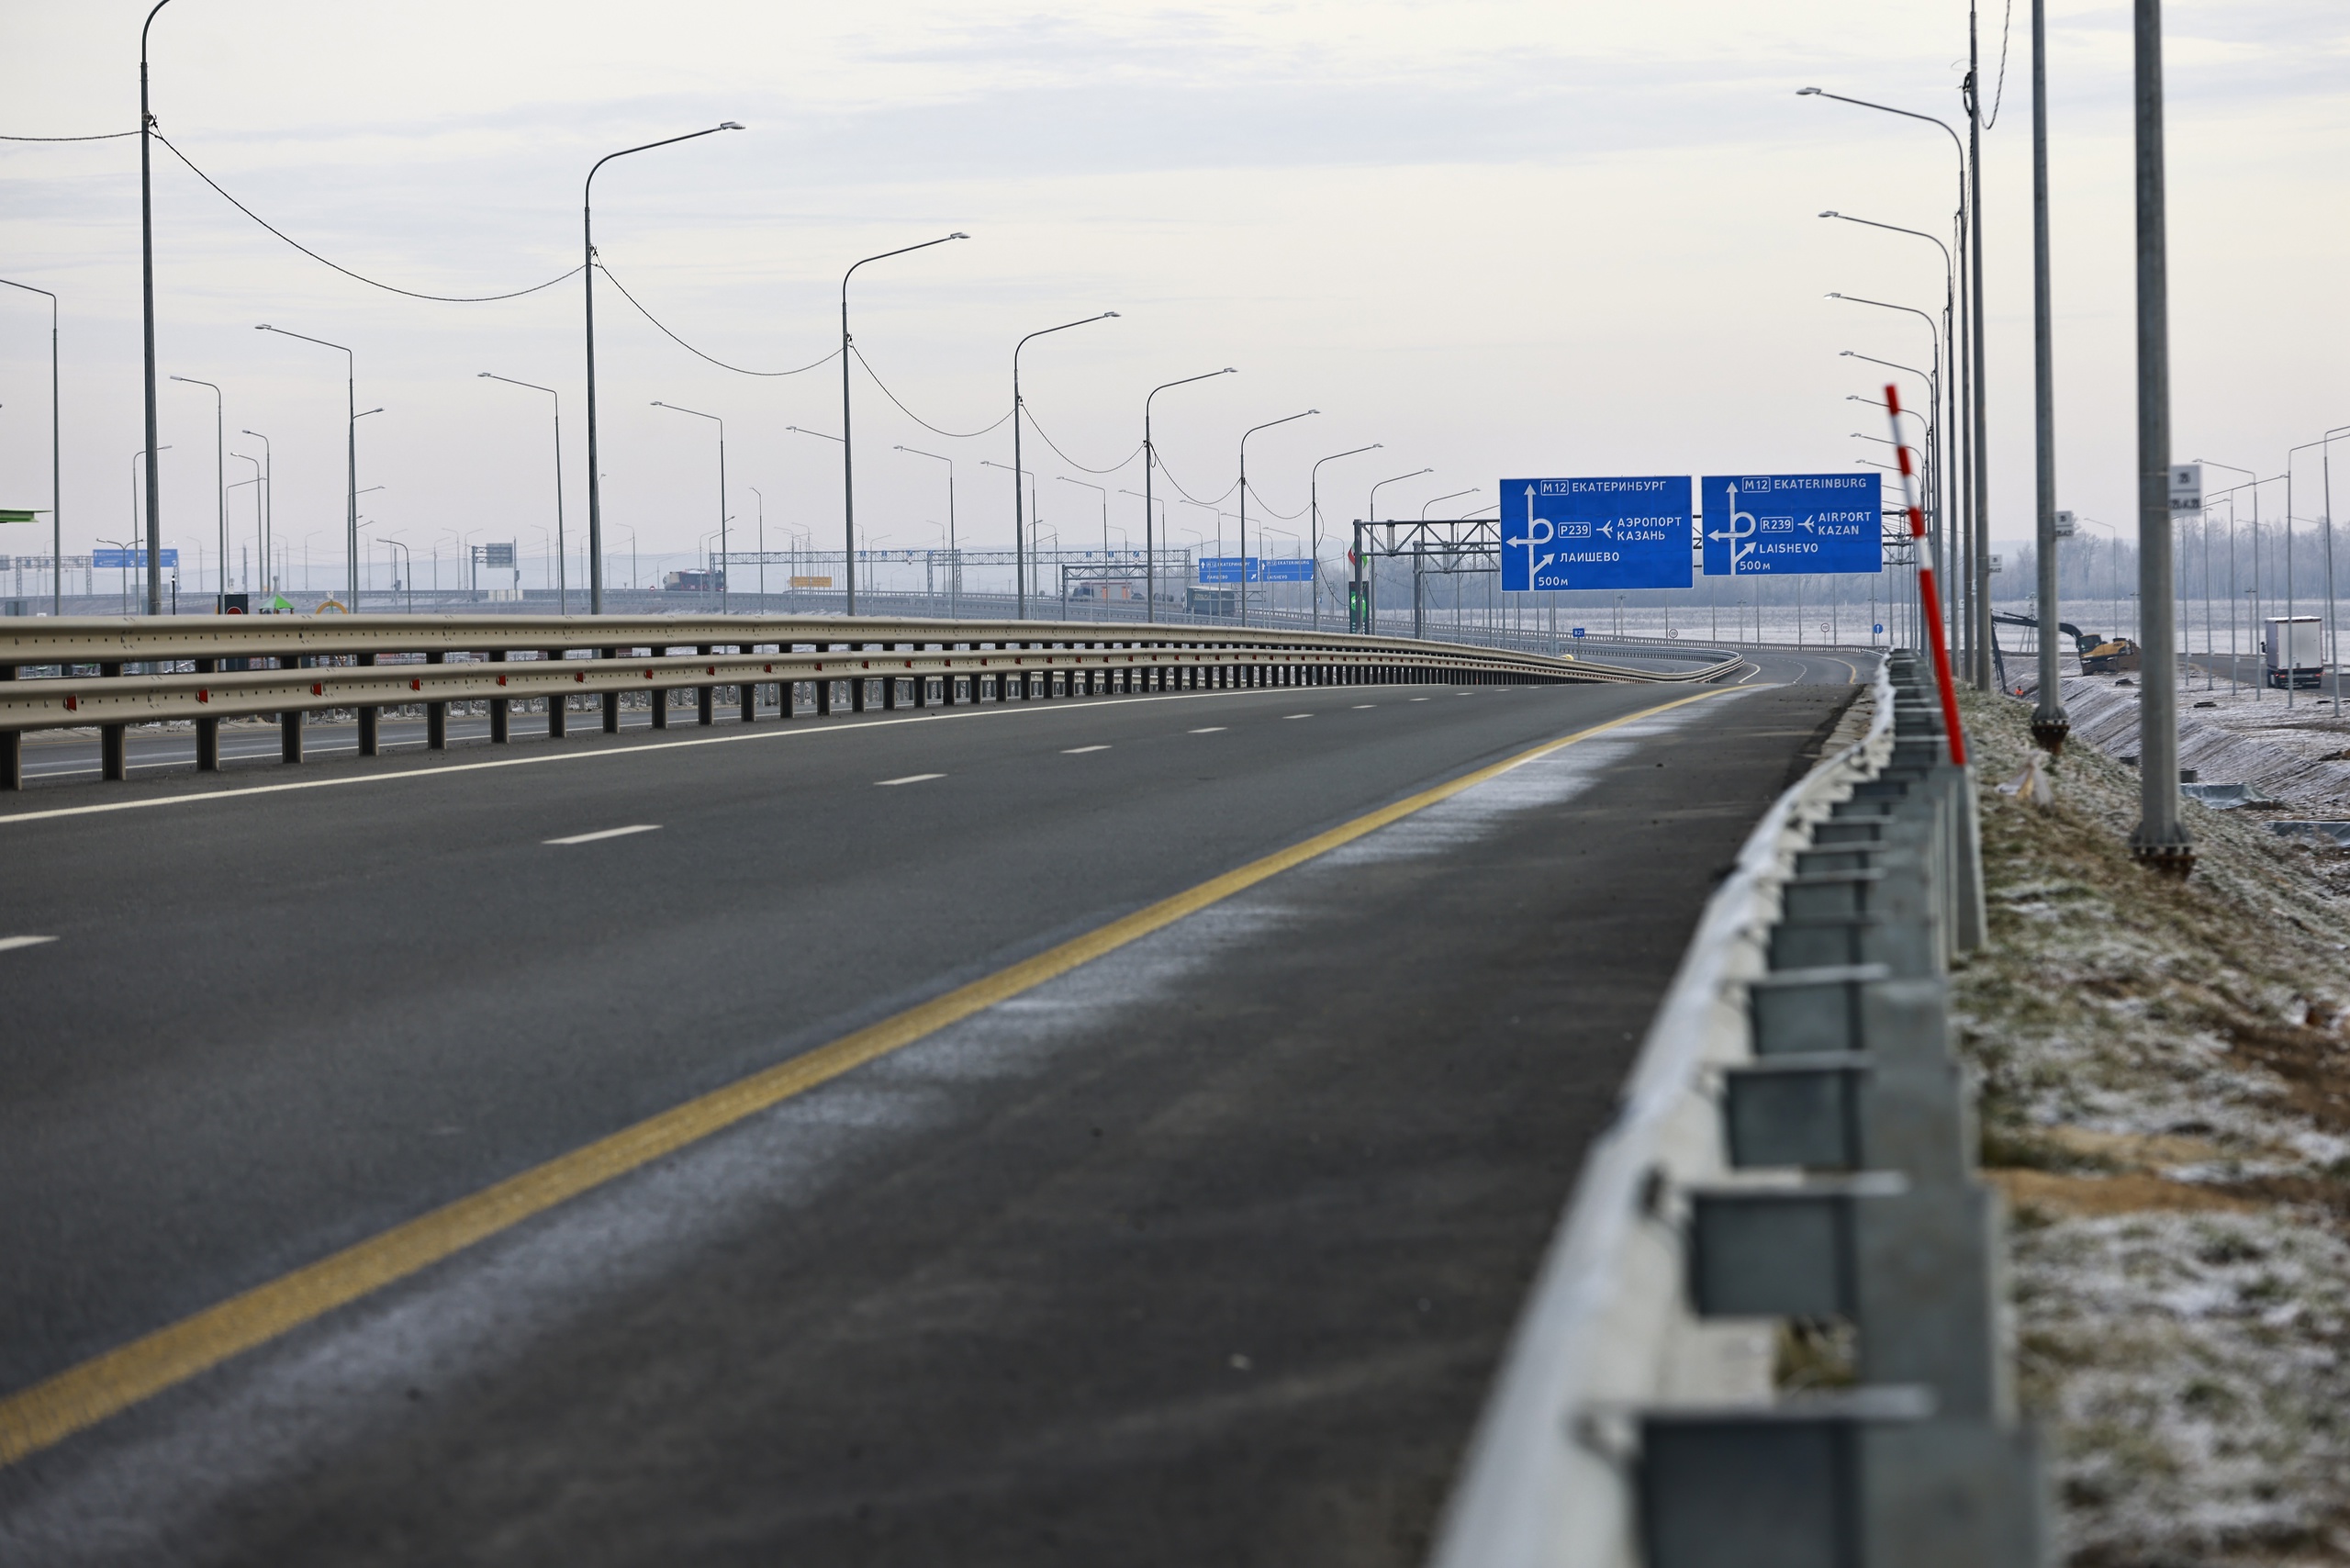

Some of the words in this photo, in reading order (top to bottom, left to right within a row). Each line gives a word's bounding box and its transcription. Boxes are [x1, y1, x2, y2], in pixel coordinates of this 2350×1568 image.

[1572, 480, 1666, 492] ЕКАТЕРИНБУРГ
[1774, 478, 1866, 489] EKATERINBURG
[1818, 511, 1872, 522] AIRPORT
[1617, 517, 1682, 528] АЭРОПОРТ
[1762, 520, 1791, 530] R239
[1561, 525, 1589, 535] Р239
[1818, 525, 1859, 535] KAZAN
[1617, 531, 1665, 541] КАЗАНЬ
[1760, 543, 1818, 554] LAISHEVO
[1560, 552, 1620, 563] ЛАИШЕВО
